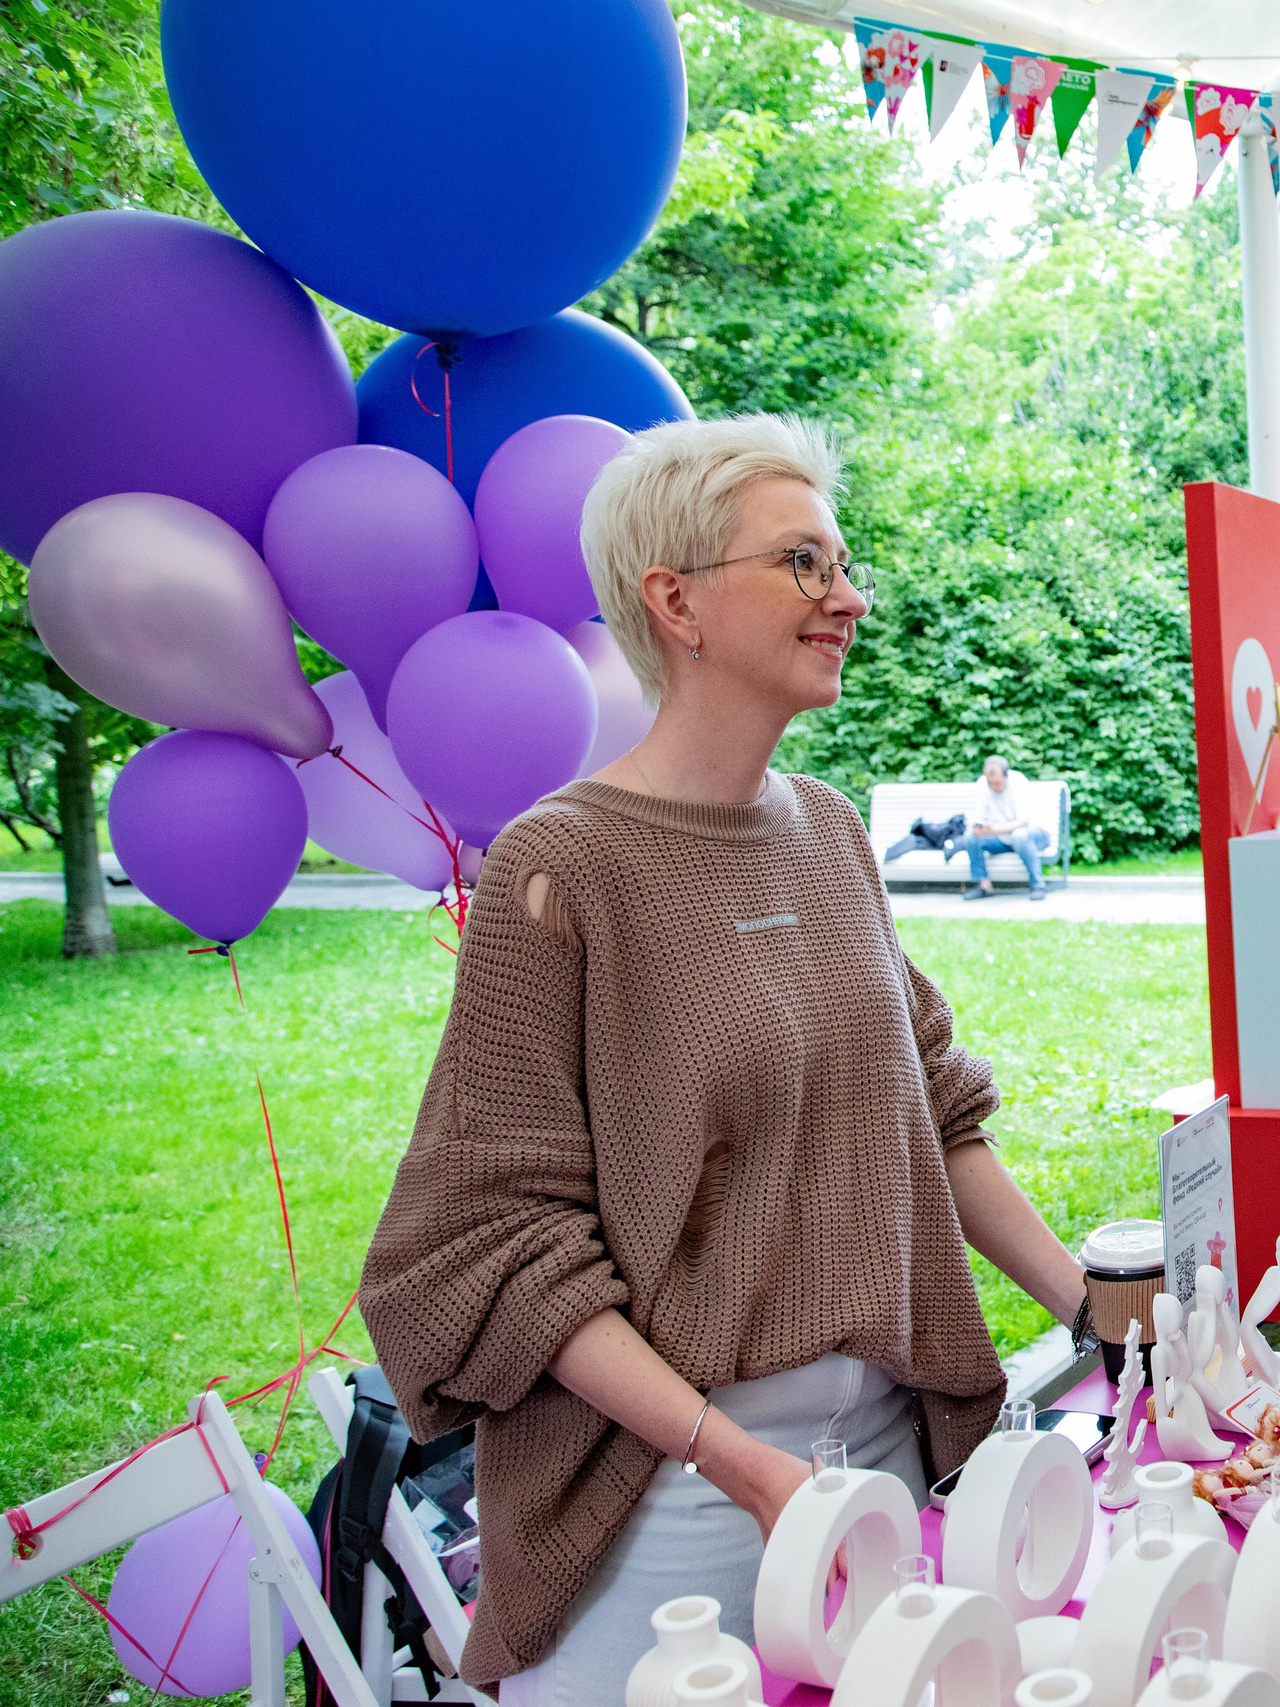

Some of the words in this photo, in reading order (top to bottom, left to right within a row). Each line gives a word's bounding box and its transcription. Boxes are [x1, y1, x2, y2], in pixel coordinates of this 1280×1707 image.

[738, 915, 798, 931] MONOCHROME
[1172, 1157, 1216, 1194] Благотворительный
[1172, 1173, 1180, 1183] Мы
[1172, 1190, 1186, 1205] фонд
